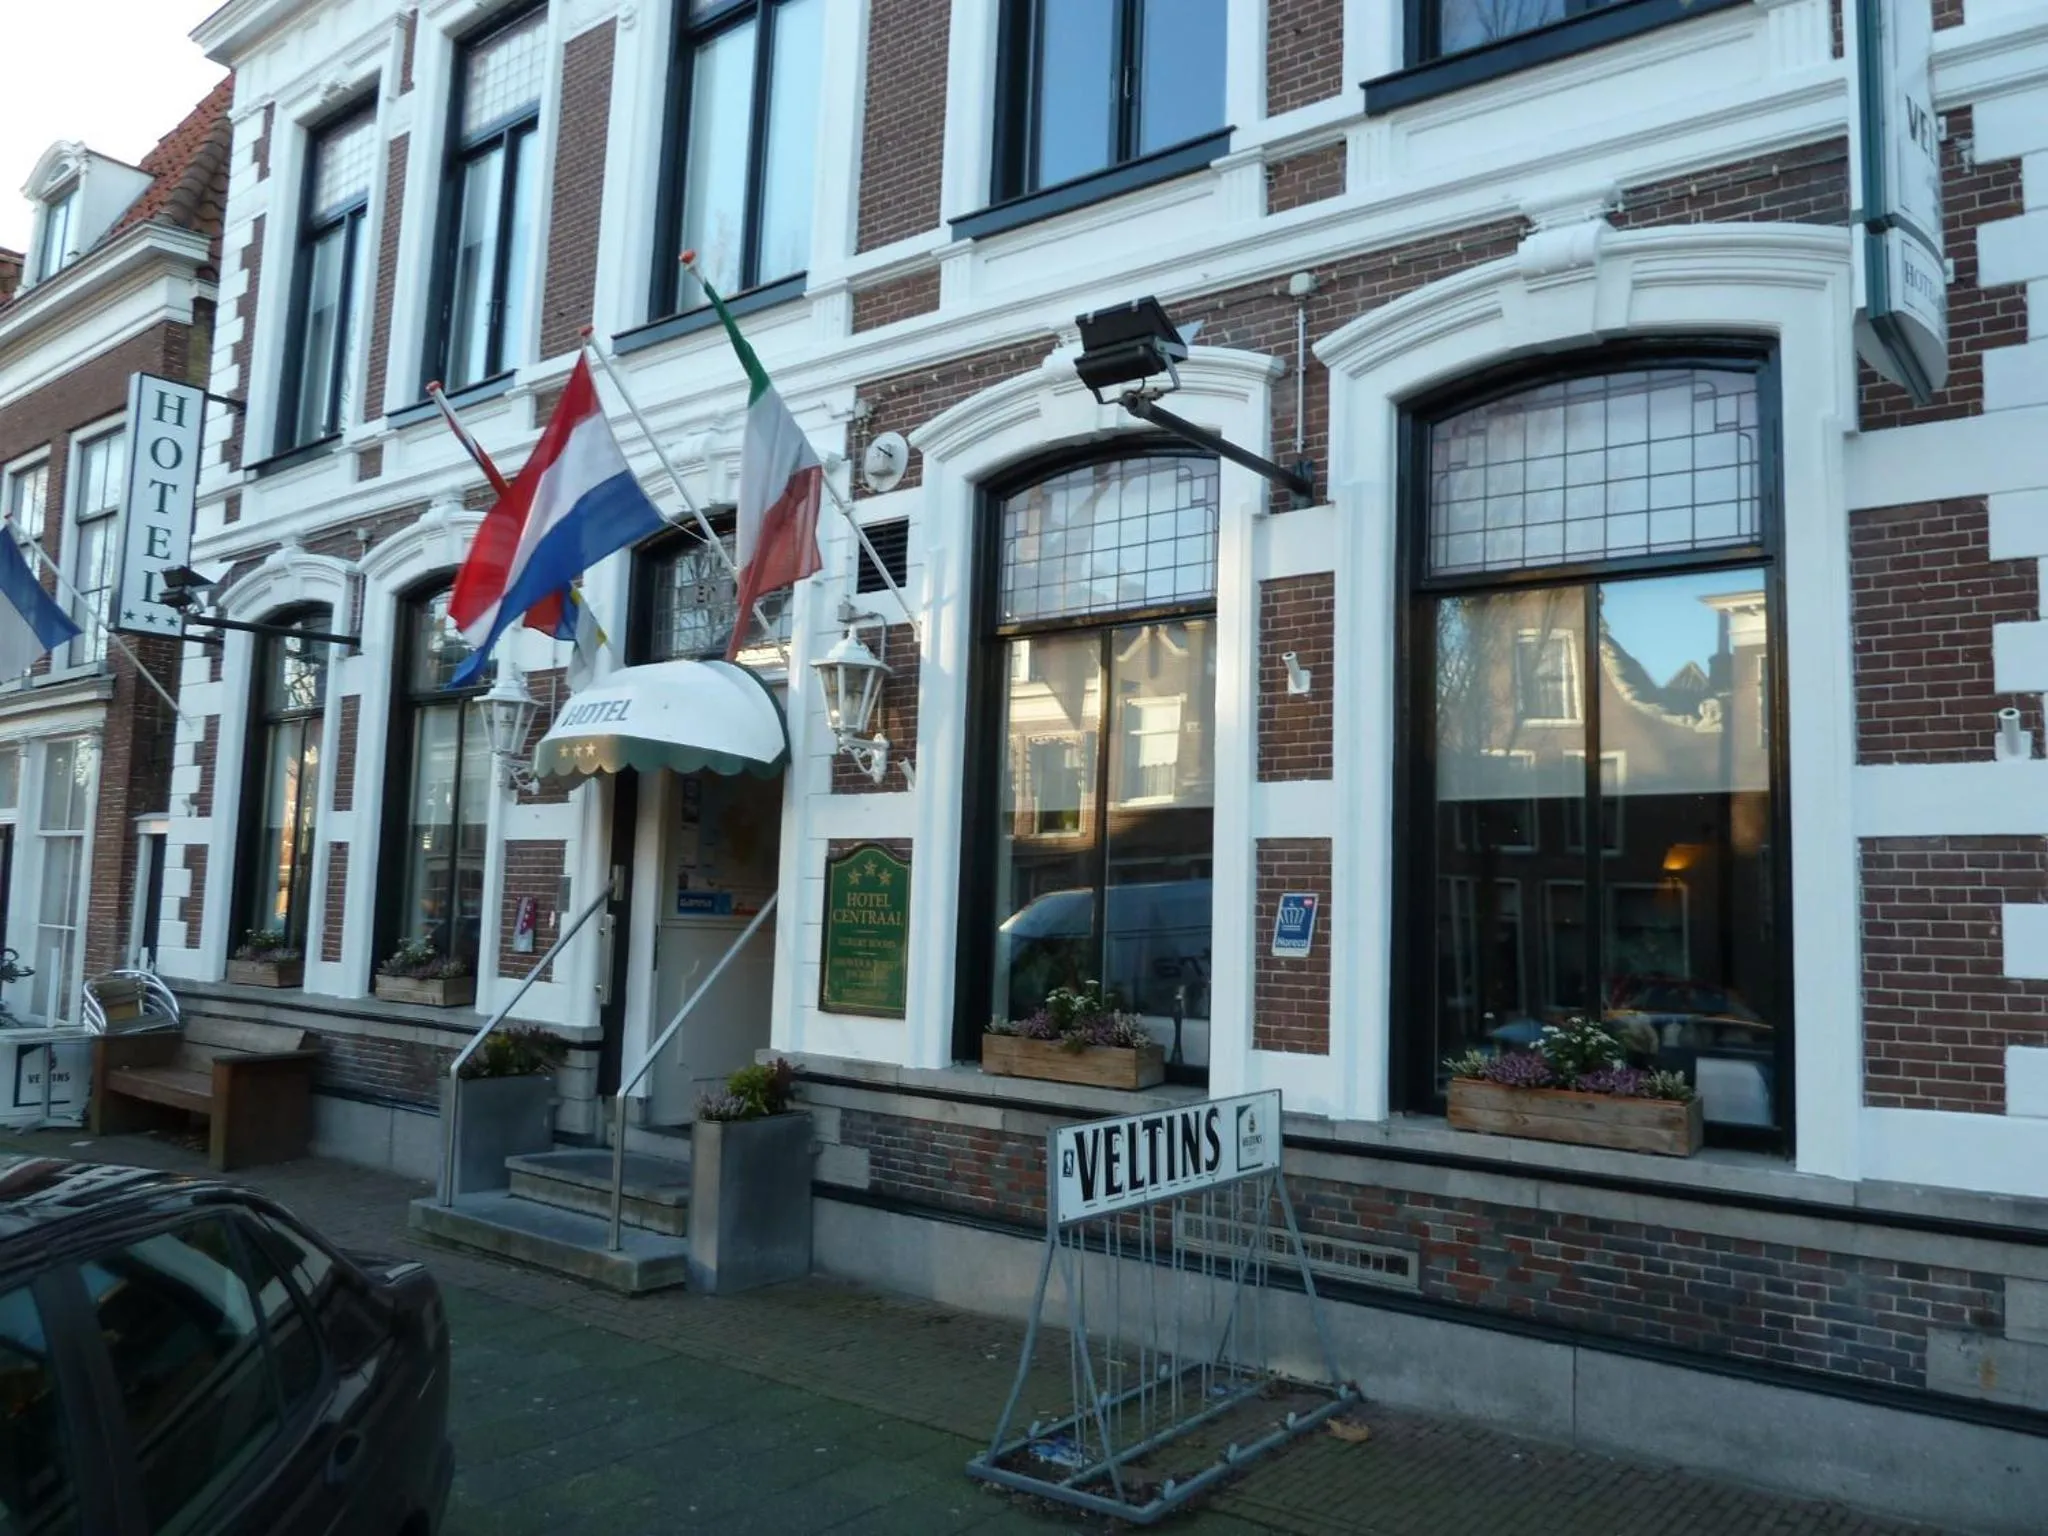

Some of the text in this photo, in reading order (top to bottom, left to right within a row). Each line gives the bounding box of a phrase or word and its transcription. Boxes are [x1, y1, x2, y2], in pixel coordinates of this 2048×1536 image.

[142, 389, 190, 607] HOTEL
[561, 698, 633, 728] HOTEL
[847, 892, 892, 907] HOTEL
[833, 909, 902, 926] CENTRAAL
[28, 1072, 70, 1084] VEINS
[1073, 1105, 1223, 1206] VELTINS
